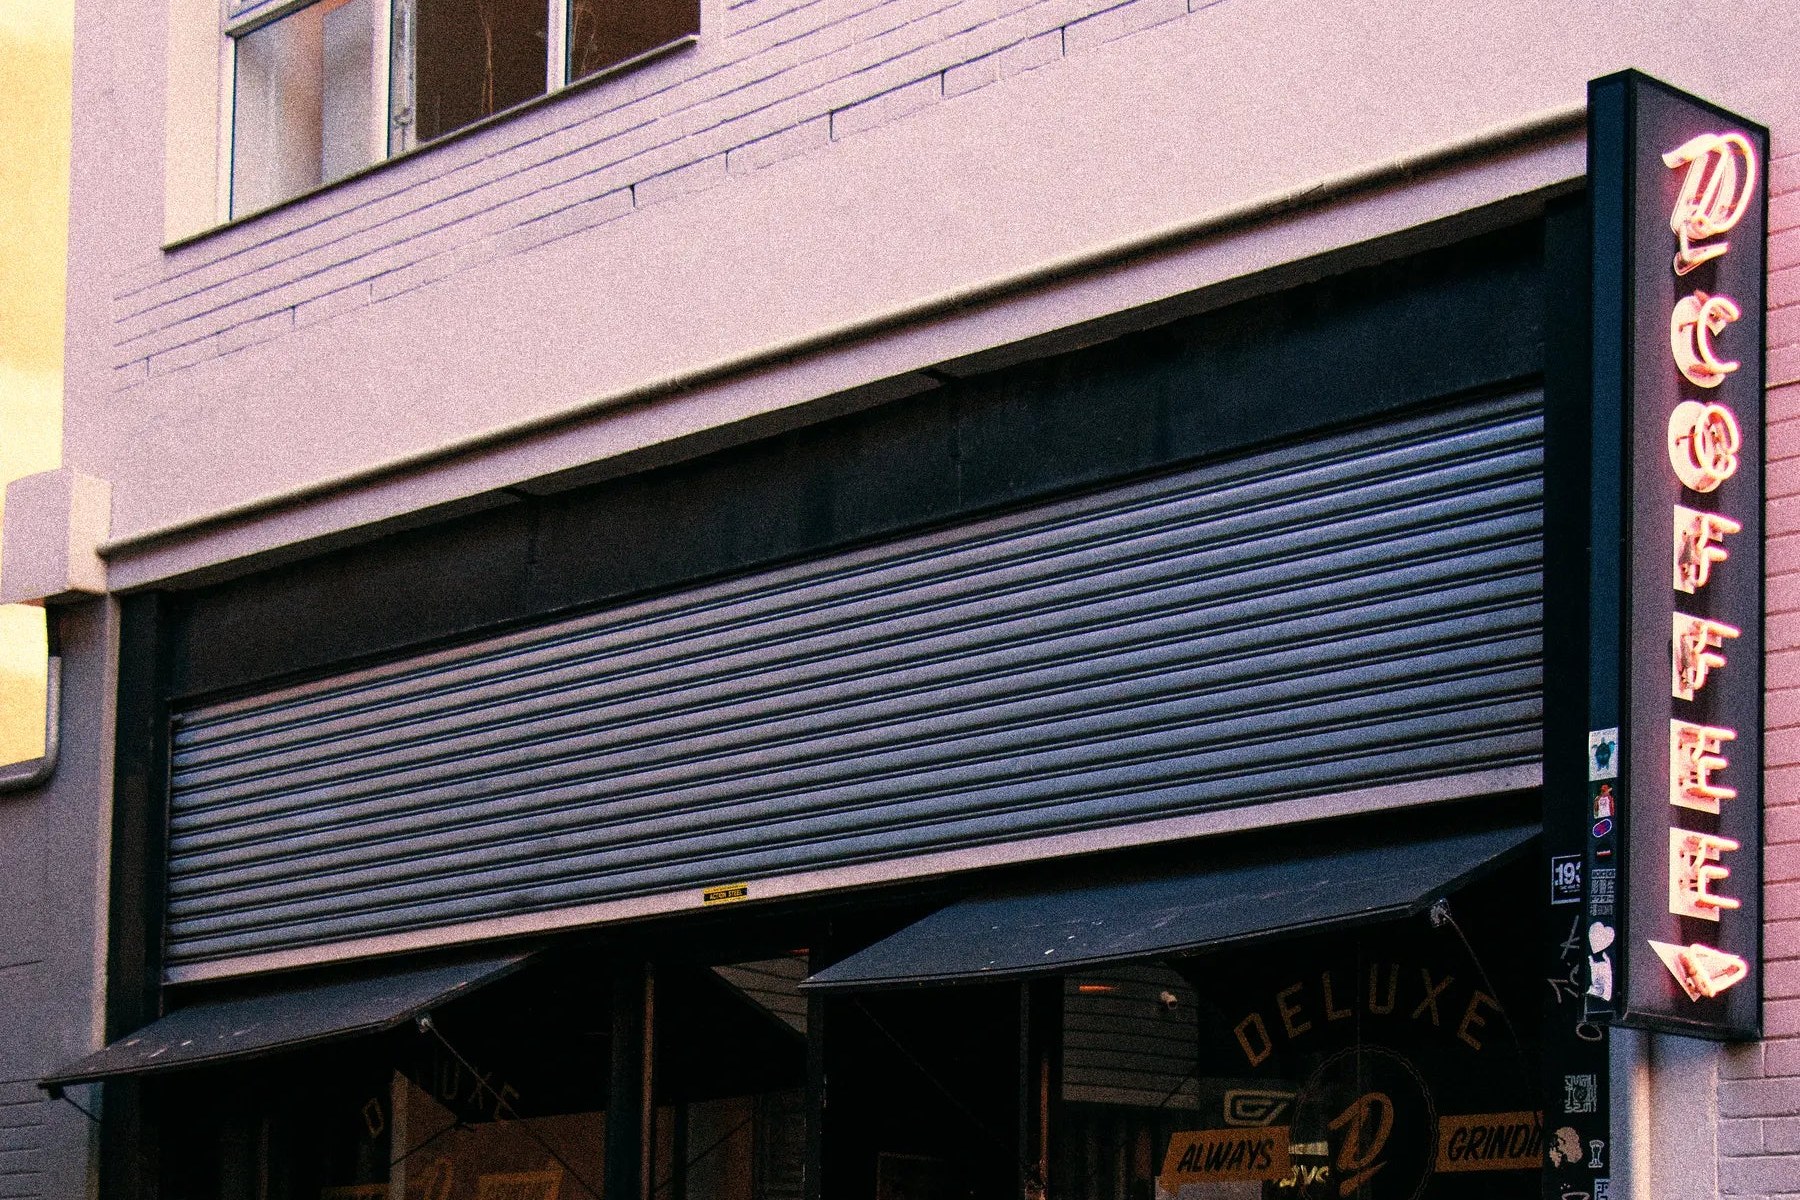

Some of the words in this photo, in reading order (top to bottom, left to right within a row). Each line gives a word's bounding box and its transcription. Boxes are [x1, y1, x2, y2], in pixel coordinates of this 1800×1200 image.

[1668, 290, 1742, 922] COFFEE
[1233, 960, 1502, 1068] DELUXE
[1177, 1139, 1273, 1173] ALWAYS
